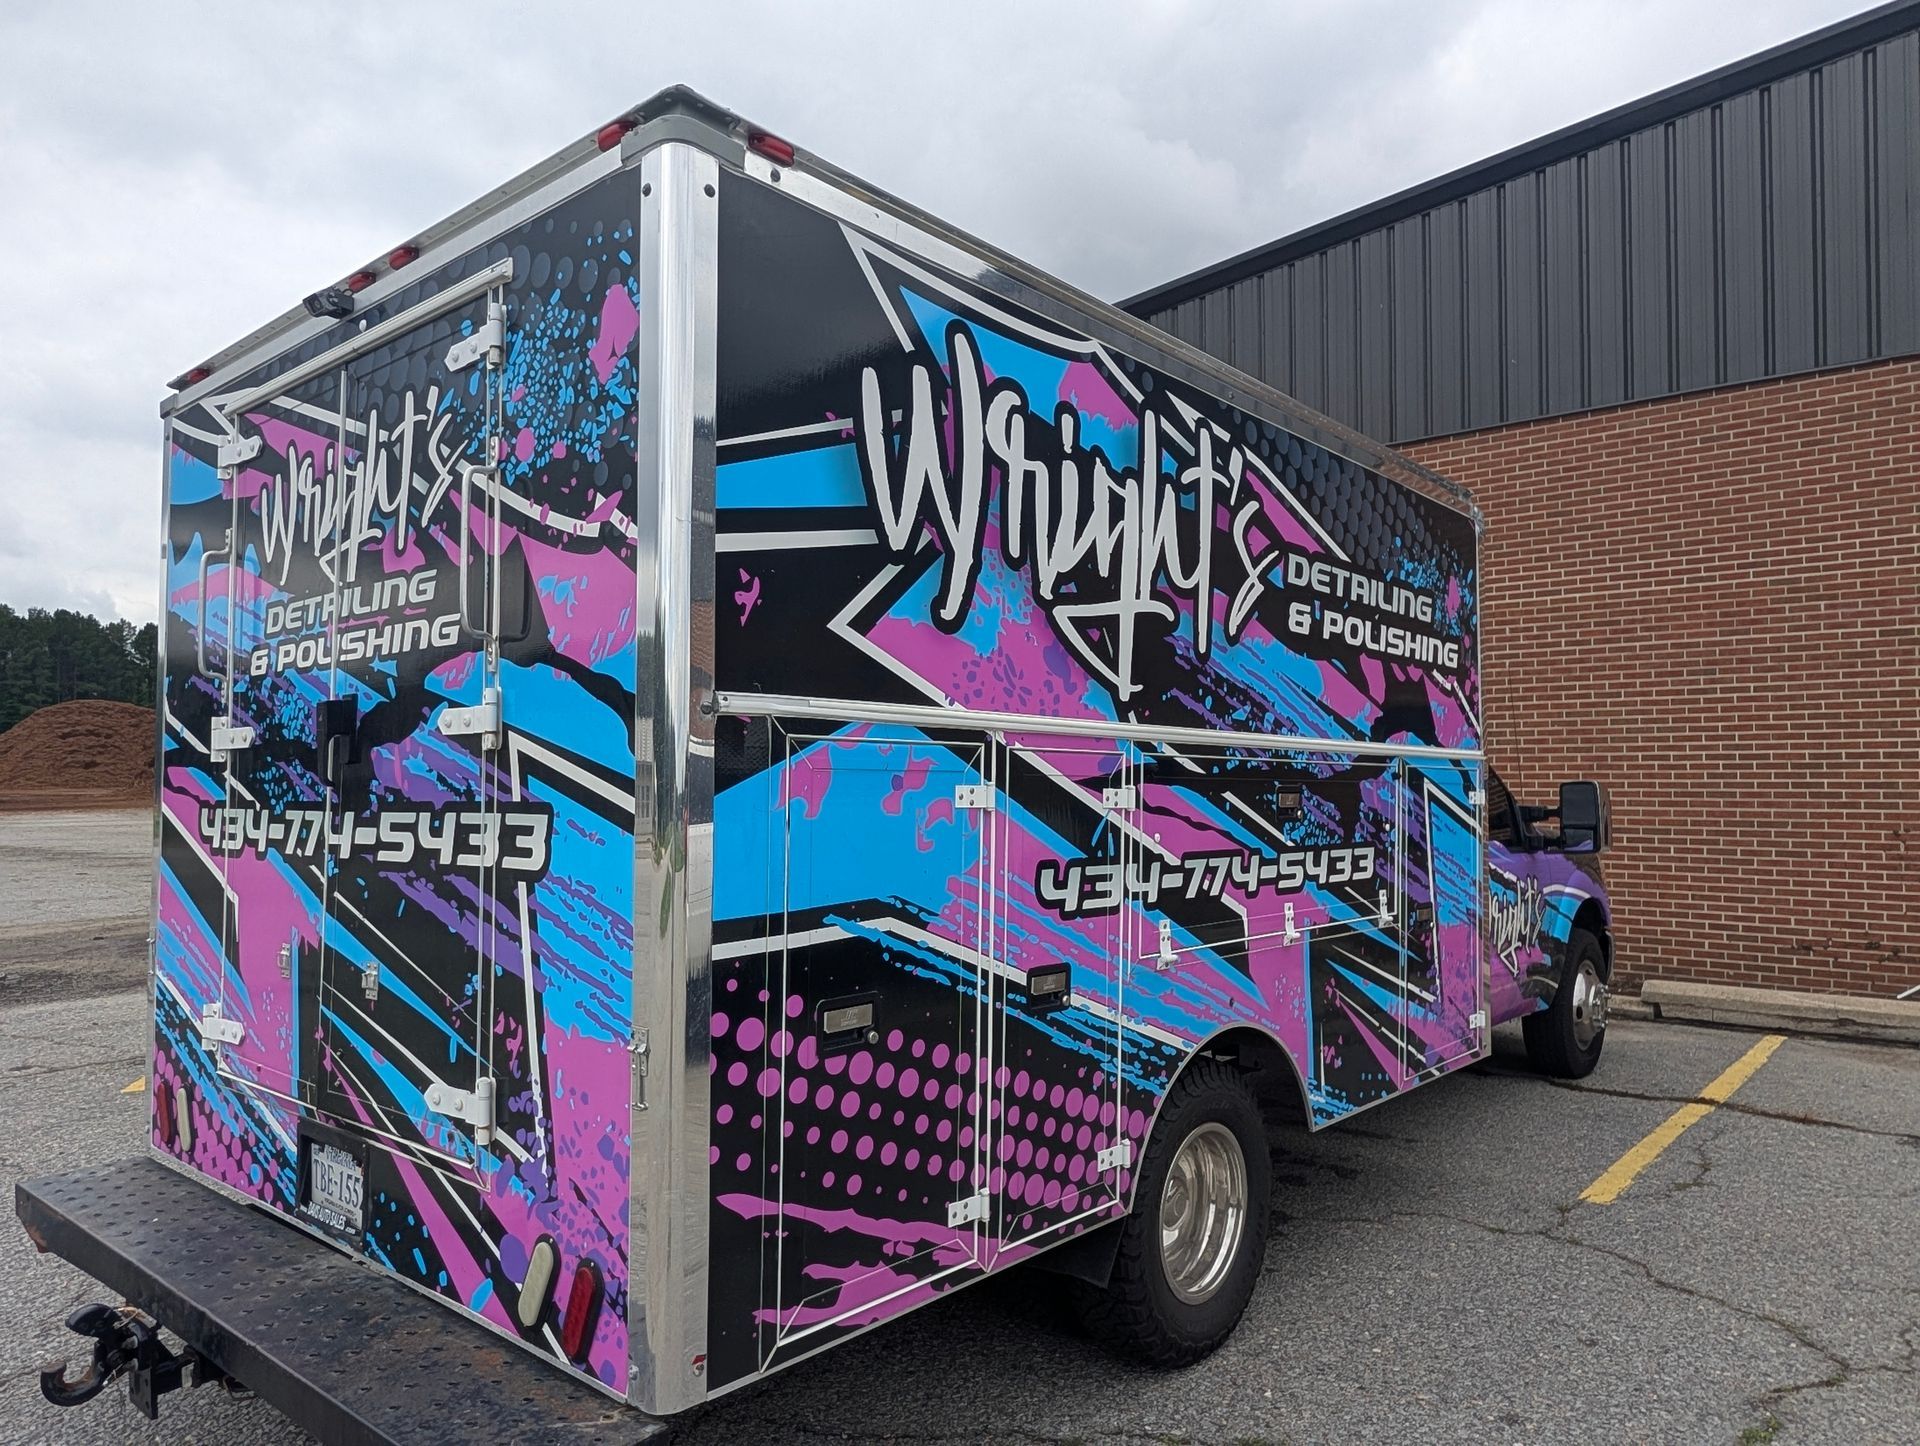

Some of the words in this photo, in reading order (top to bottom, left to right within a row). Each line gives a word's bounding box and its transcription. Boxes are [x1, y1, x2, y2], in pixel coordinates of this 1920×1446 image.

[262, 385, 469, 586] Wright's
[862, 333, 1279, 701] Wright's
[266, 569, 438, 634] DETAILING
[1287, 552, 1433, 623] DETAILING
[250, 649, 269, 676] &
[1288, 601, 1312, 635] &
[1323, 609, 1459, 668] POLISHING
[201, 808, 549, 871] 434-774-5433
[1040, 847, 1375, 912] 434-774-5433
[1489, 876, 1546, 978] right's
[313, 1158, 361, 1208] TBE-155
